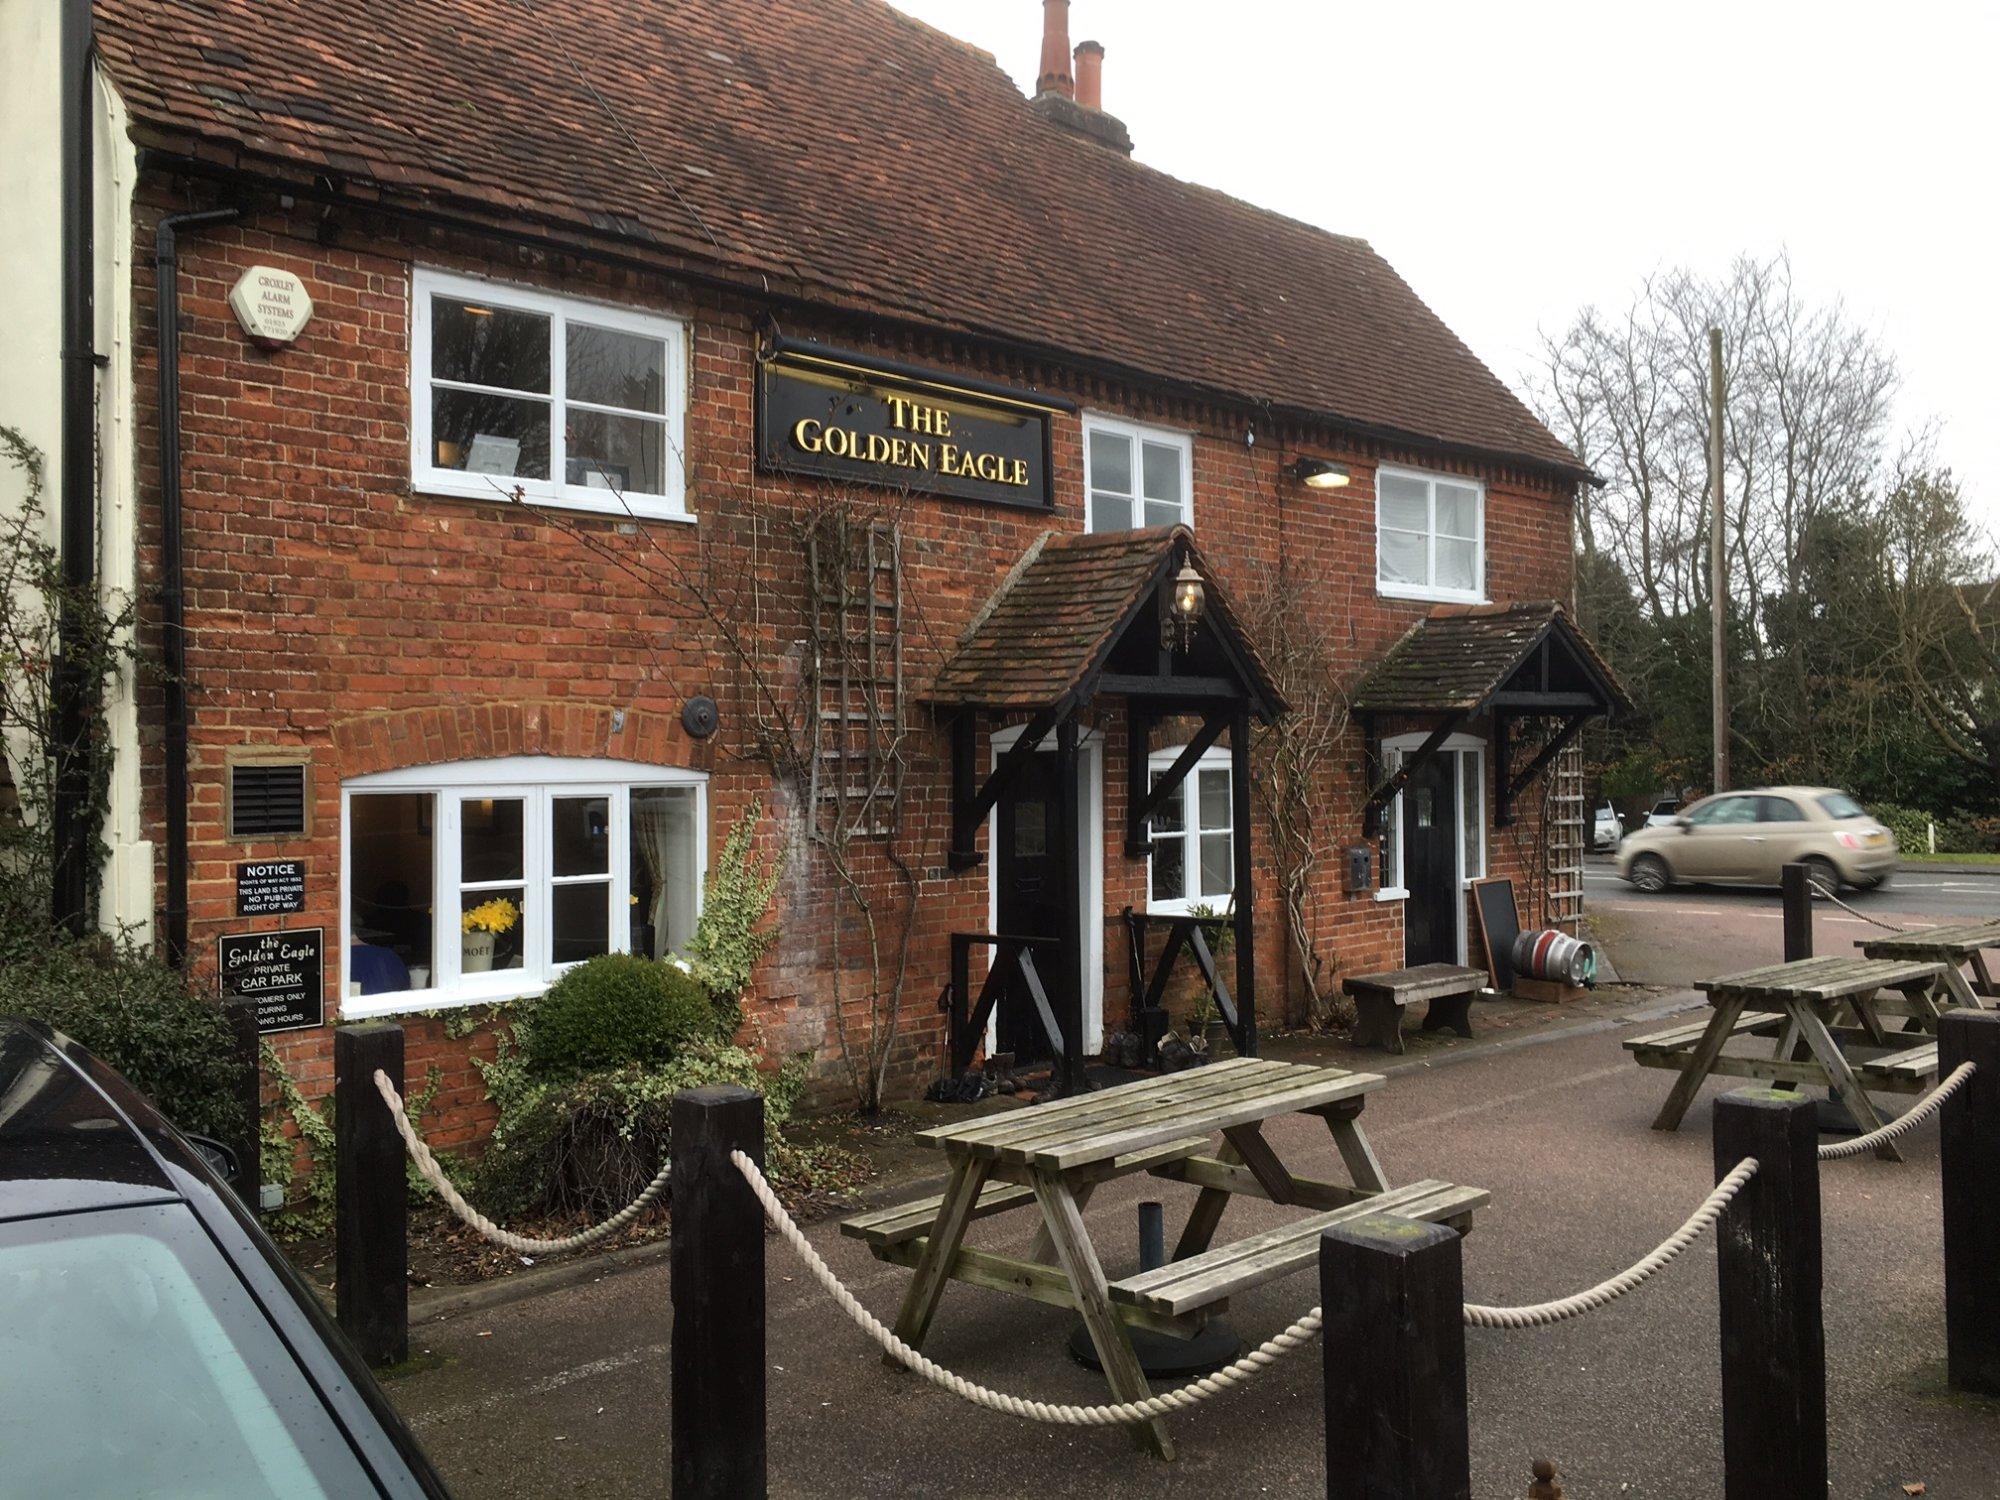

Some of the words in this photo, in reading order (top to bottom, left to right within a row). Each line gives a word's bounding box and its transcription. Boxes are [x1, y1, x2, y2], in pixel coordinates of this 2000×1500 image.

[258, 276, 294, 292] CROXLEY
[261, 291, 291, 305] ALARM
[257, 303, 295, 319] SYSTEMS
[888, 394, 951, 438] THE
[795, 418, 930, 471] GOLDEN
[939, 443, 1029, 486] EAGLE
[246, 864, 295, 877] NOTICE
[239, 888, 253, 896] THIS
[280, 884, 304, 892] PRIVATE
[248, 895, 261, 903] NO
[264, 893, 293, 902] PUBLIC
[243, 903, 267, 912] RIGHT
[268, 902, 280, 910] OF
[282, 901, 298, 909] WAY
[260, 936, 279, 949] the
[228, 948, 274, 968] Golden
[280, 943, 315, 961] Eagle
[254, 963, 290, 975] PRIVATE
[241, 976, 267, 989] CAR
[271, 973, 303, 986] PARK
[286, 992, 306, 1001] ONLY
[258, 1004, 287, 1015] DURING
[277, 1013, 304, 1023] HOURS
